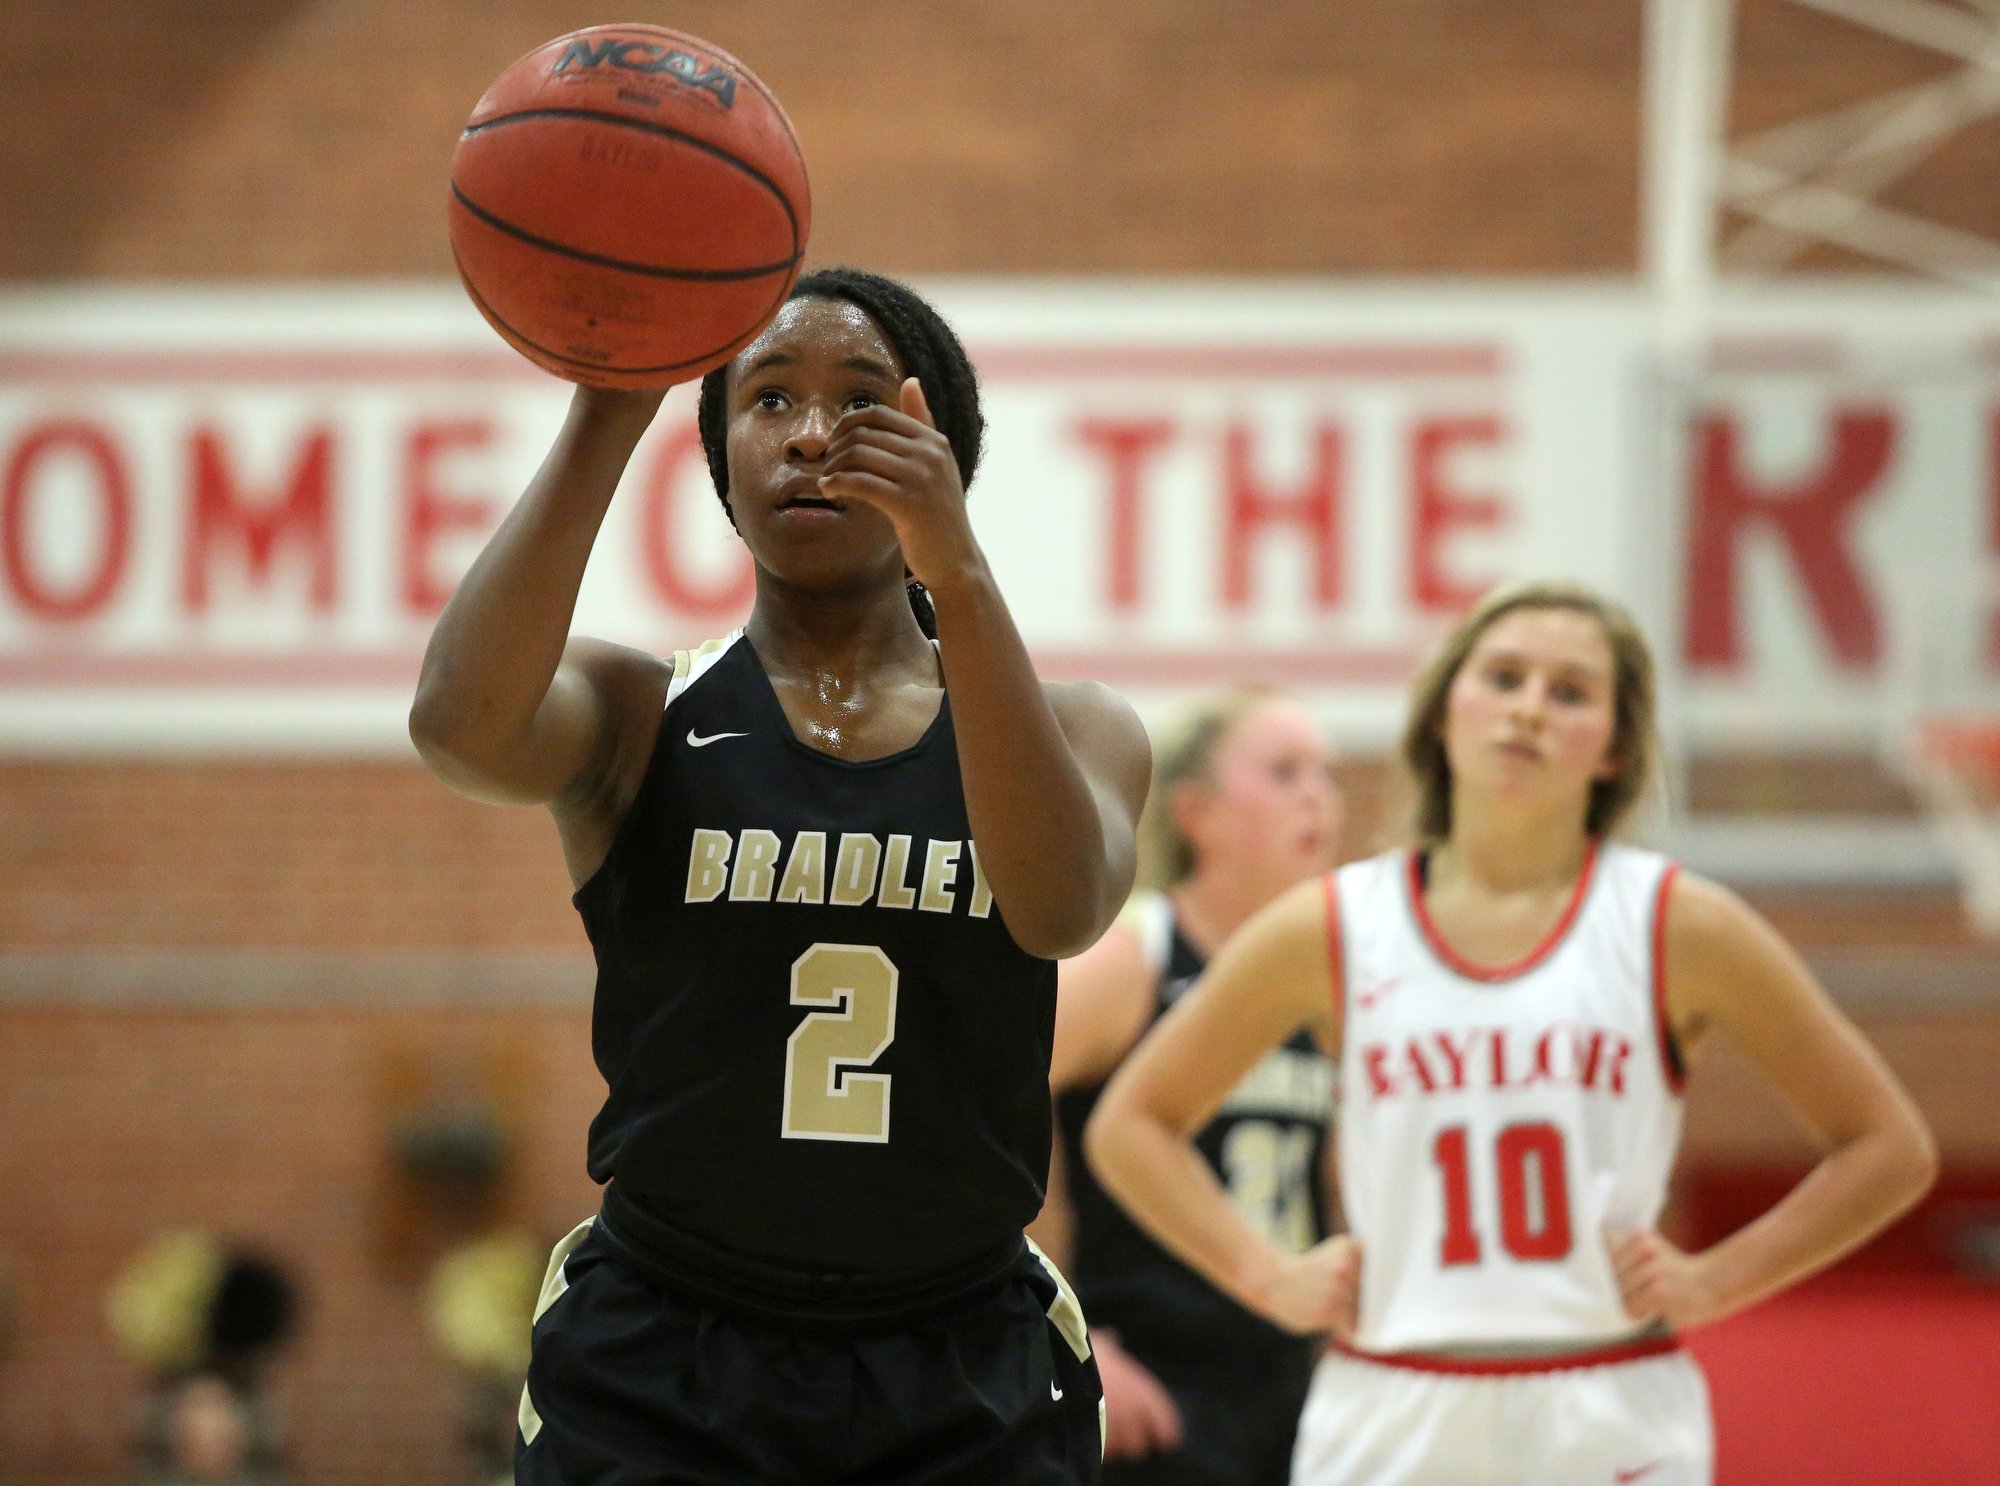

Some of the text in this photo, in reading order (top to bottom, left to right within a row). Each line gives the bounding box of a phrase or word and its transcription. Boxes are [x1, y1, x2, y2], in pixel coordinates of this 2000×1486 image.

[551, 38, 738, 111] NCAA
[1066, 412, 1508, 613] THE
[781, 942, 900, 1144] 2
[1433, 1121, 1574, 1267] 10
